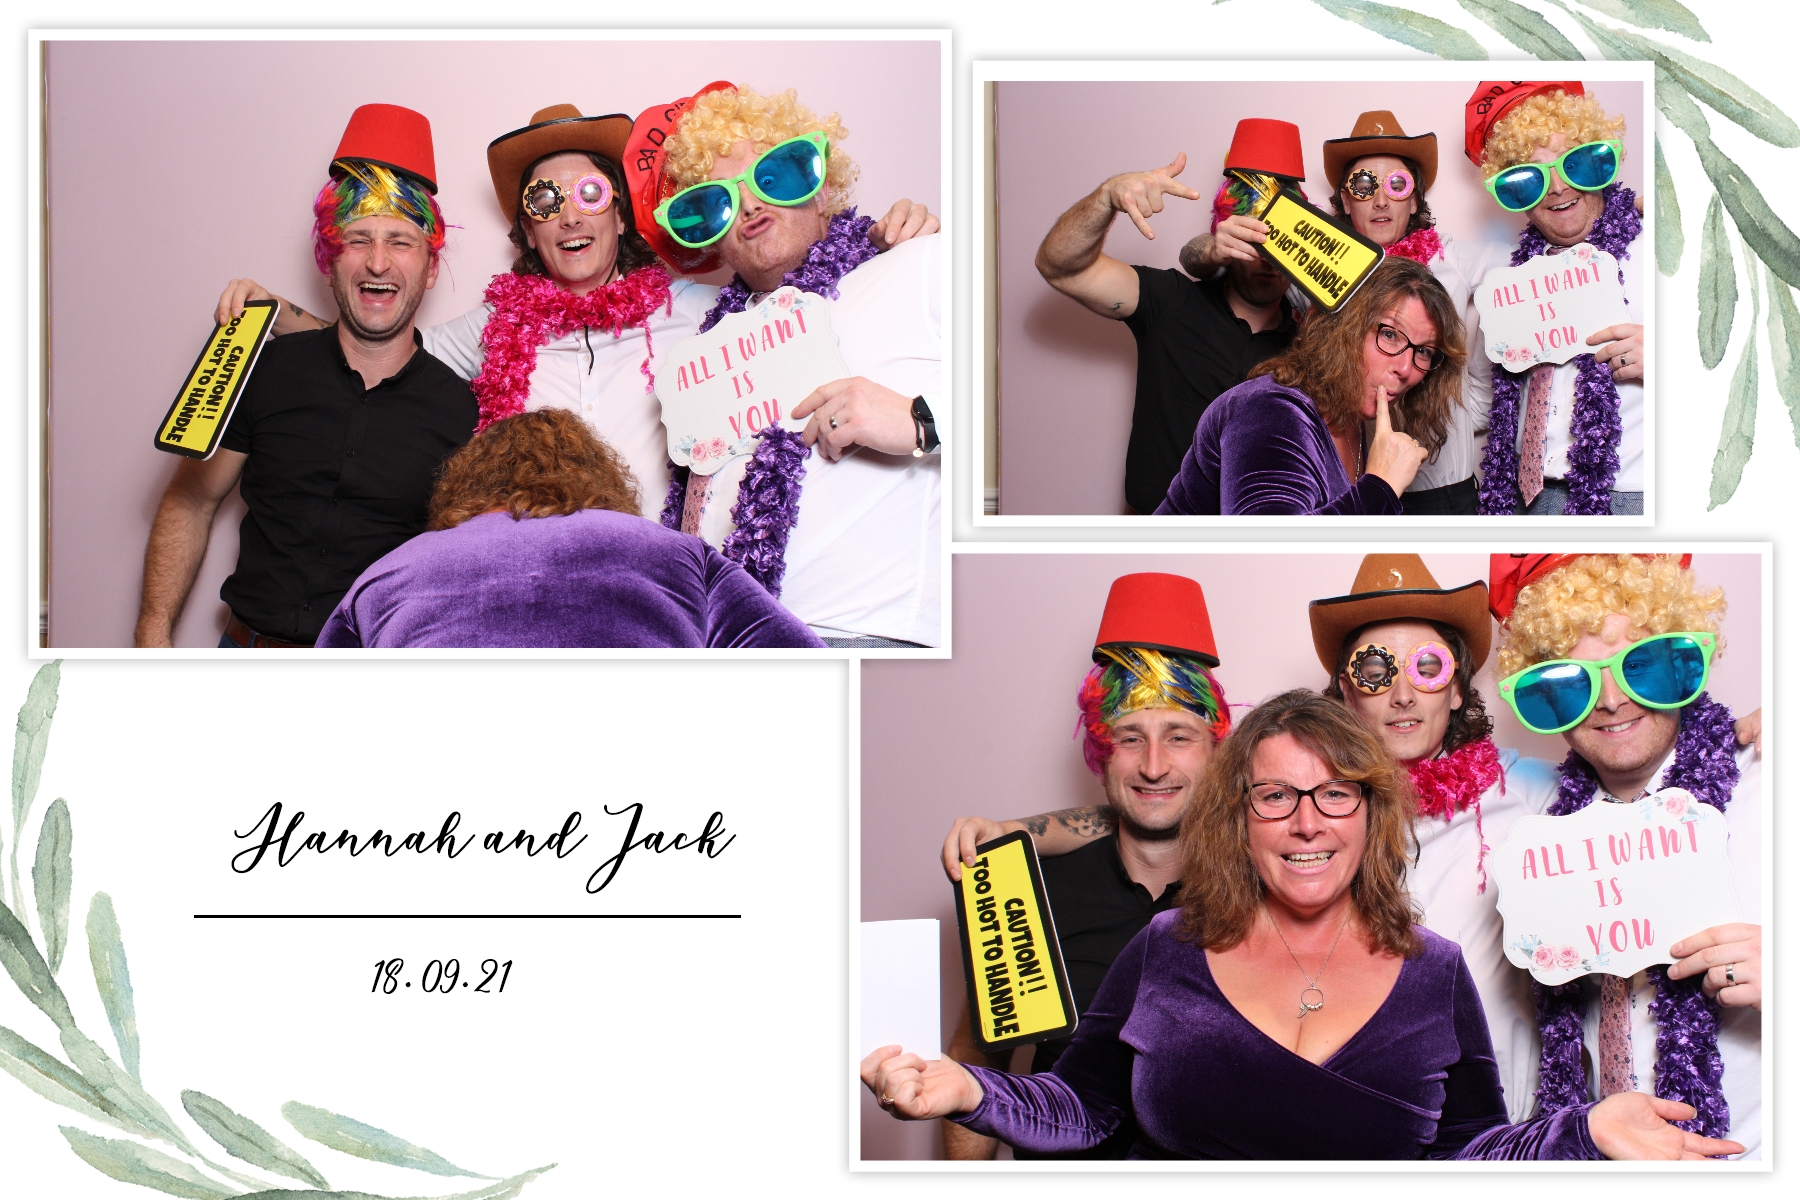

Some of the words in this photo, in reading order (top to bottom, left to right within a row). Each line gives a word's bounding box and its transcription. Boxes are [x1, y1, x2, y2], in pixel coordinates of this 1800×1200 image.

[1477, 86, 1505, 115] BAD
[637, 128, 666, 172] BAD
[1293, 220, 1350, 265] CAUTION!!
[1275, 233, 1299, 256] HOT
[1292, 246, 1310, 266] TO
[1303, 257, 1349, 299] HANDLE
[1493, 284, 1525, 308] ALL
[1528, 278, 1540, 299] I
[1544, 262, 1600, 294] WANT
[1537, 302, 1556, 321] IS
[208, 338, 232, 365] HOT
[677, 356, 715, 392] ALL
[719, 343, 734, 371] I
[738, 308, 807, 361] WANT
[1534, 326, 1578, 351] YOU
[197, 368, 217, 385] TO
[197, 346, 244, 420] CAUTION!!
[731, 371, 754, 399] IS
[165, 387, 206, 443] HANDLE
[728, 398, 782, 439] YOU
[1521, 843, 1574, 880] ALL
[1582, 837, 1599, 871] I
[1608, 819, 1698, 866] WANT
[972, 856, 991, 894] TOO
[1593, 877, 1623, 908] IS
[975, 895, 1001, 932] HOT
[981, 933, 1004, 961] TO
[1004, 897, 1048, 997] CAUTION!!
[1585, 918, 1655, 955] YOU
[984, 962, 1020, 1038] HANDLE
